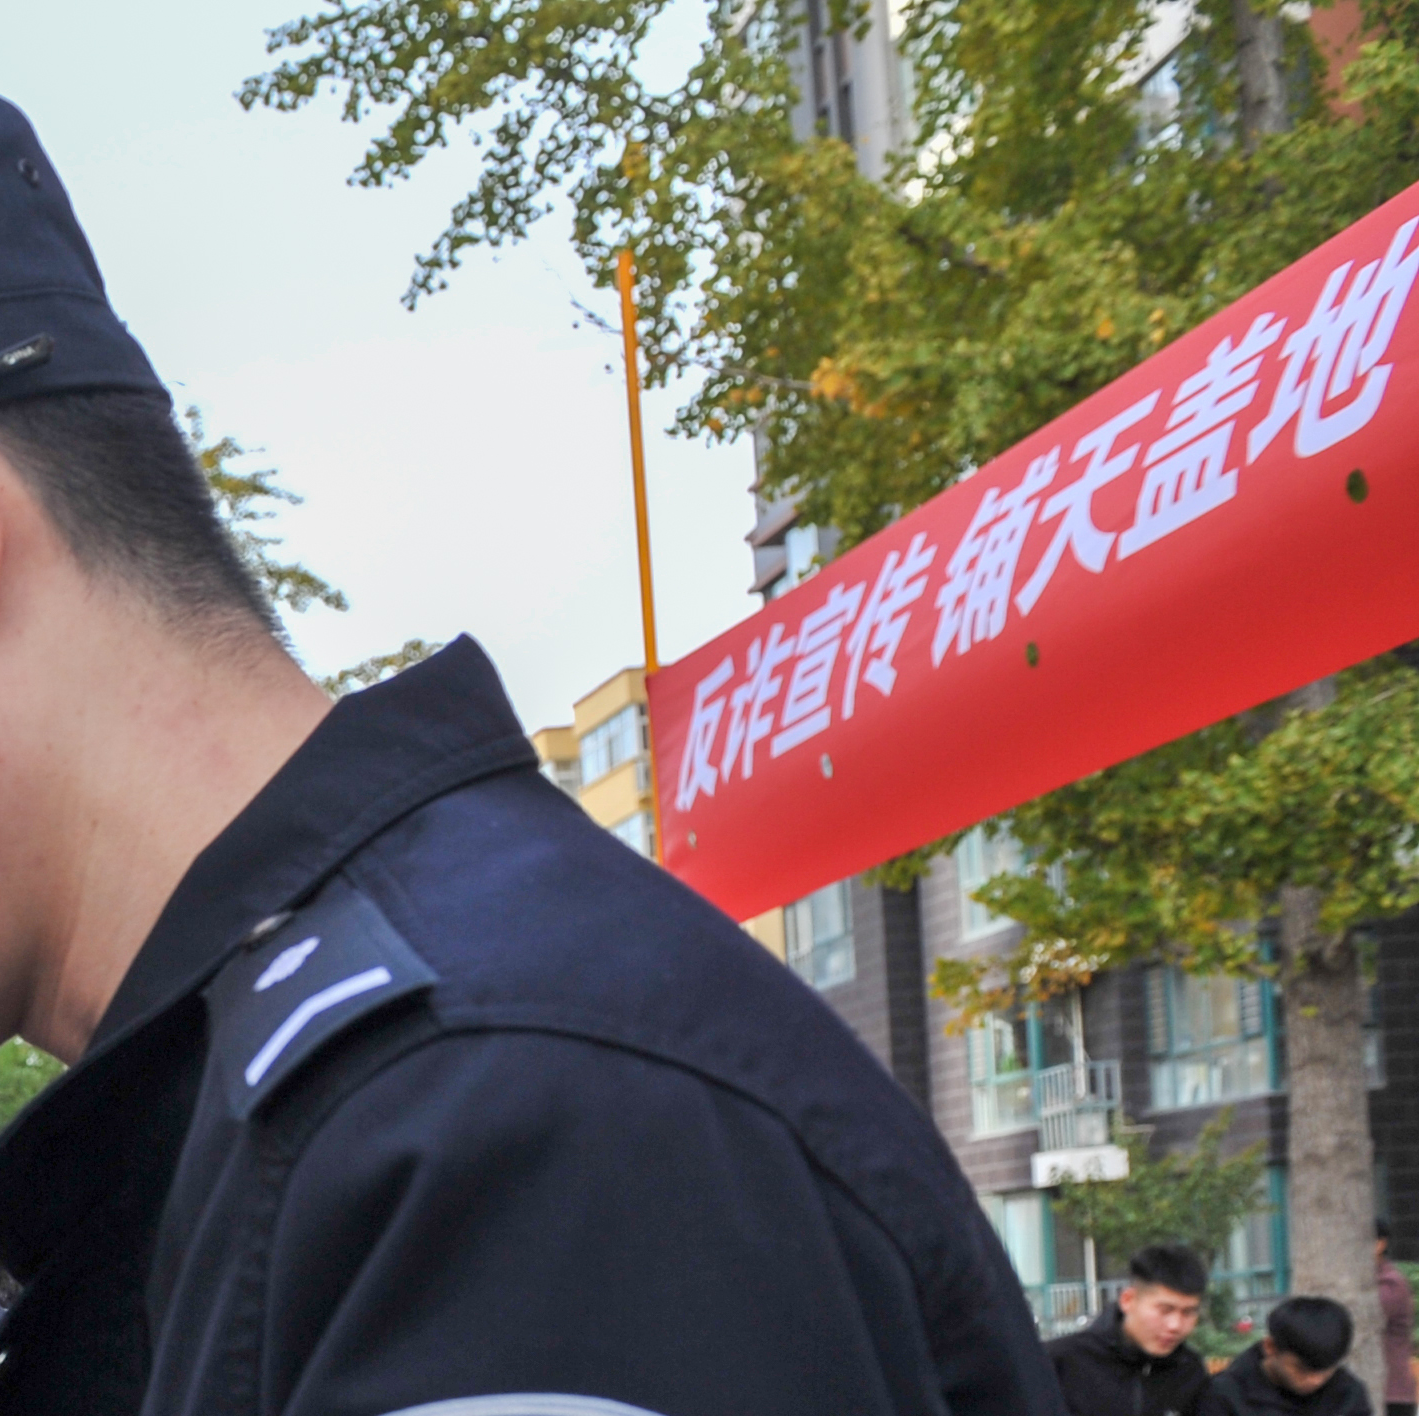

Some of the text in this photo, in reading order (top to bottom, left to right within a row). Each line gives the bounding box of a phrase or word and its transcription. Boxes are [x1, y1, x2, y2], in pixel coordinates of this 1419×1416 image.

[673, 215, 1419, 812] 反诈宣传 铺天盖地
